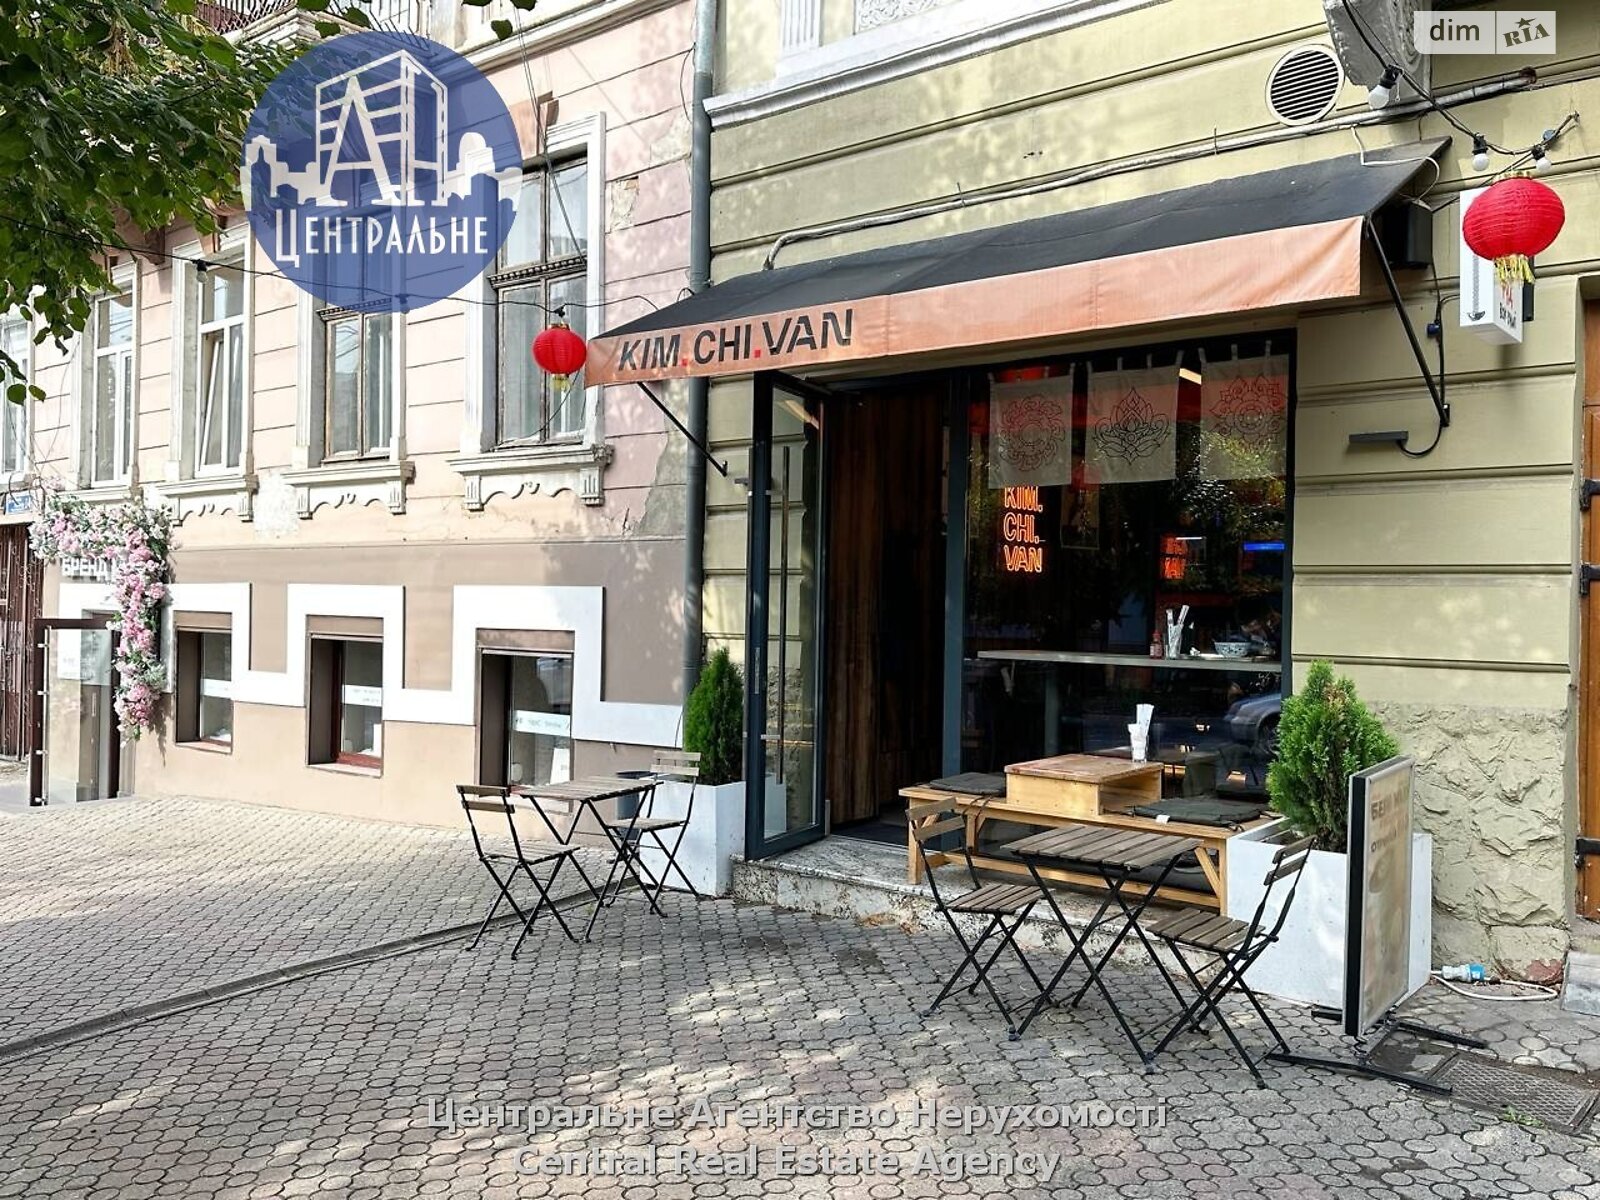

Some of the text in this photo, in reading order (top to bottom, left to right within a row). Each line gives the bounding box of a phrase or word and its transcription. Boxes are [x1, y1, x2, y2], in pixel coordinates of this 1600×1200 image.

[1004, 485, 1043, 512] KIM.
[1003, 511, 1040, 544] CHI.
[61, 557, 111, 582] БРЕНД
[1003, 544, 1043, 573] VAN
